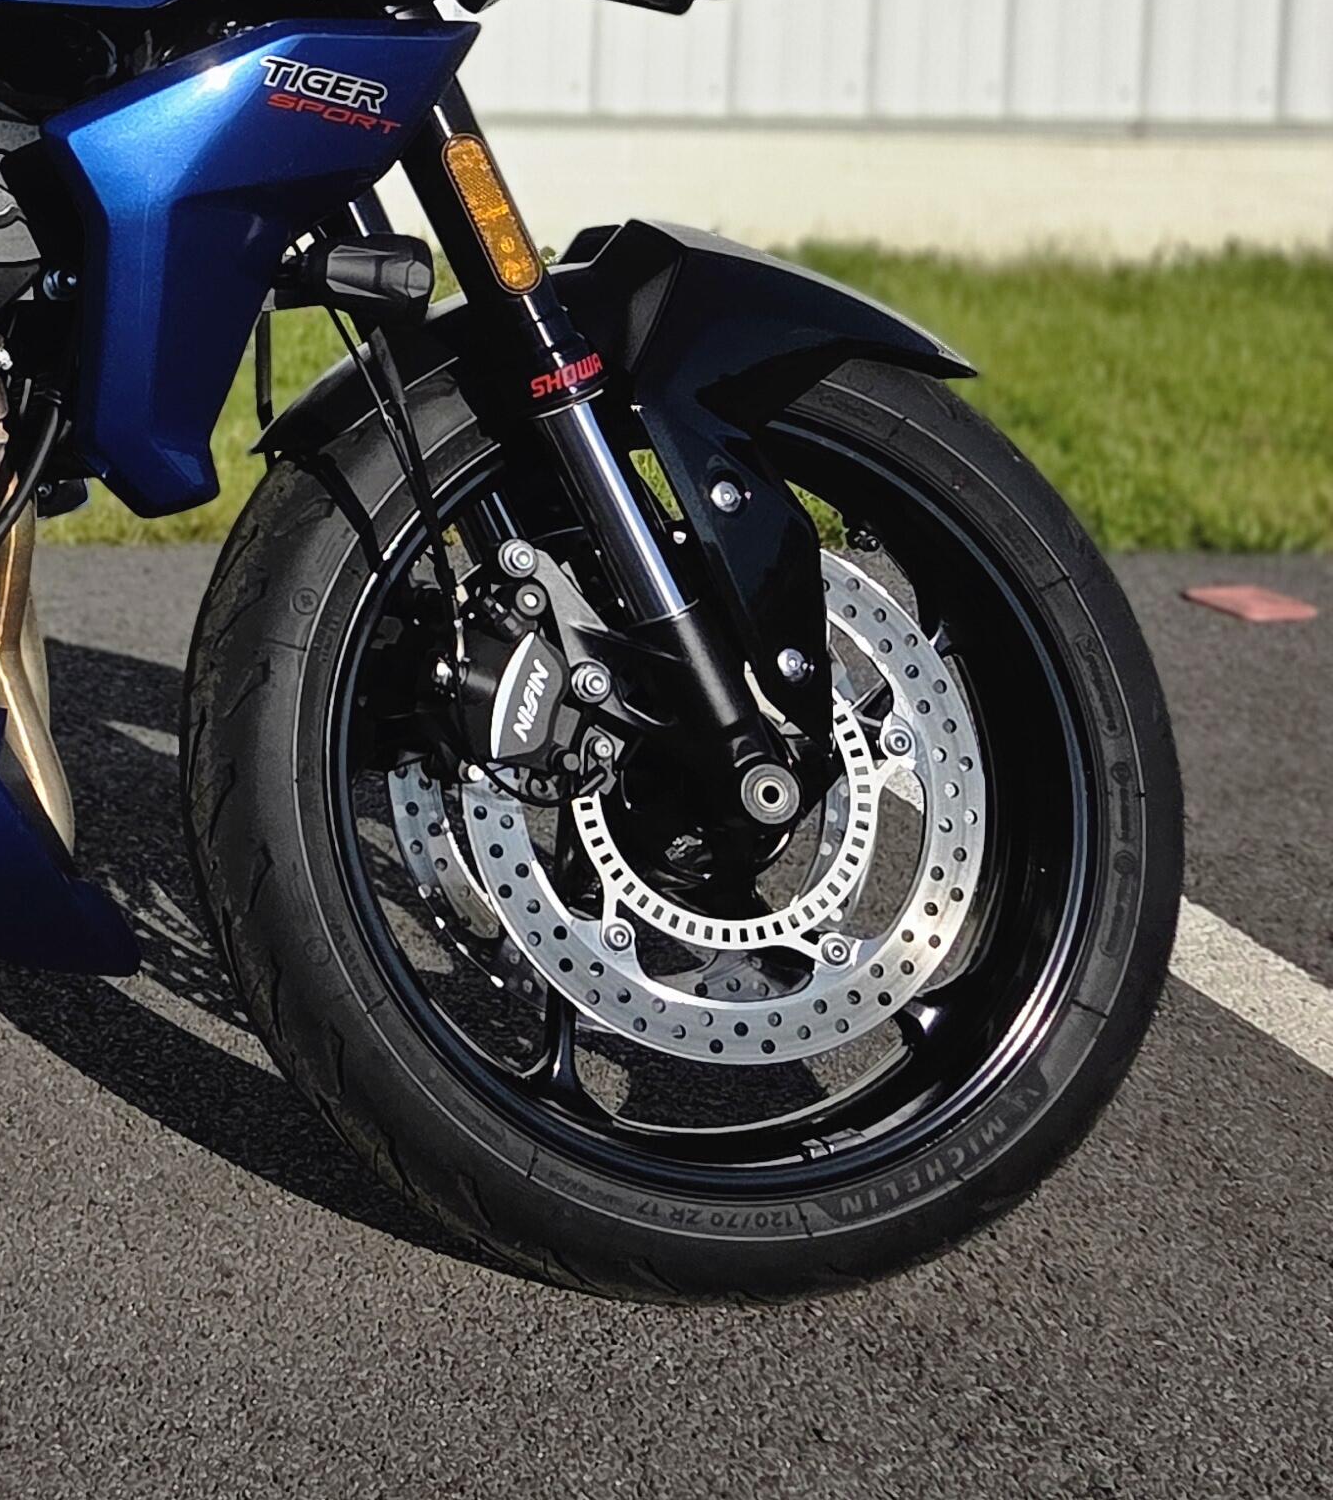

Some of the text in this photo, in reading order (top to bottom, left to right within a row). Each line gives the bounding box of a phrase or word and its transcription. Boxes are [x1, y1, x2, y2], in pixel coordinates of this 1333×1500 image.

[260, 56, 389, 114] TIGER
[266, 93, 401, 135] SPORT
[530, 352, 603, 399] SHOWA
[510, 657, 550, 744] NISSIN
[839, 1114, 1008, 1217] MICHELIN
[636, 1199, 794, 1230] 120/70 ZR 17
